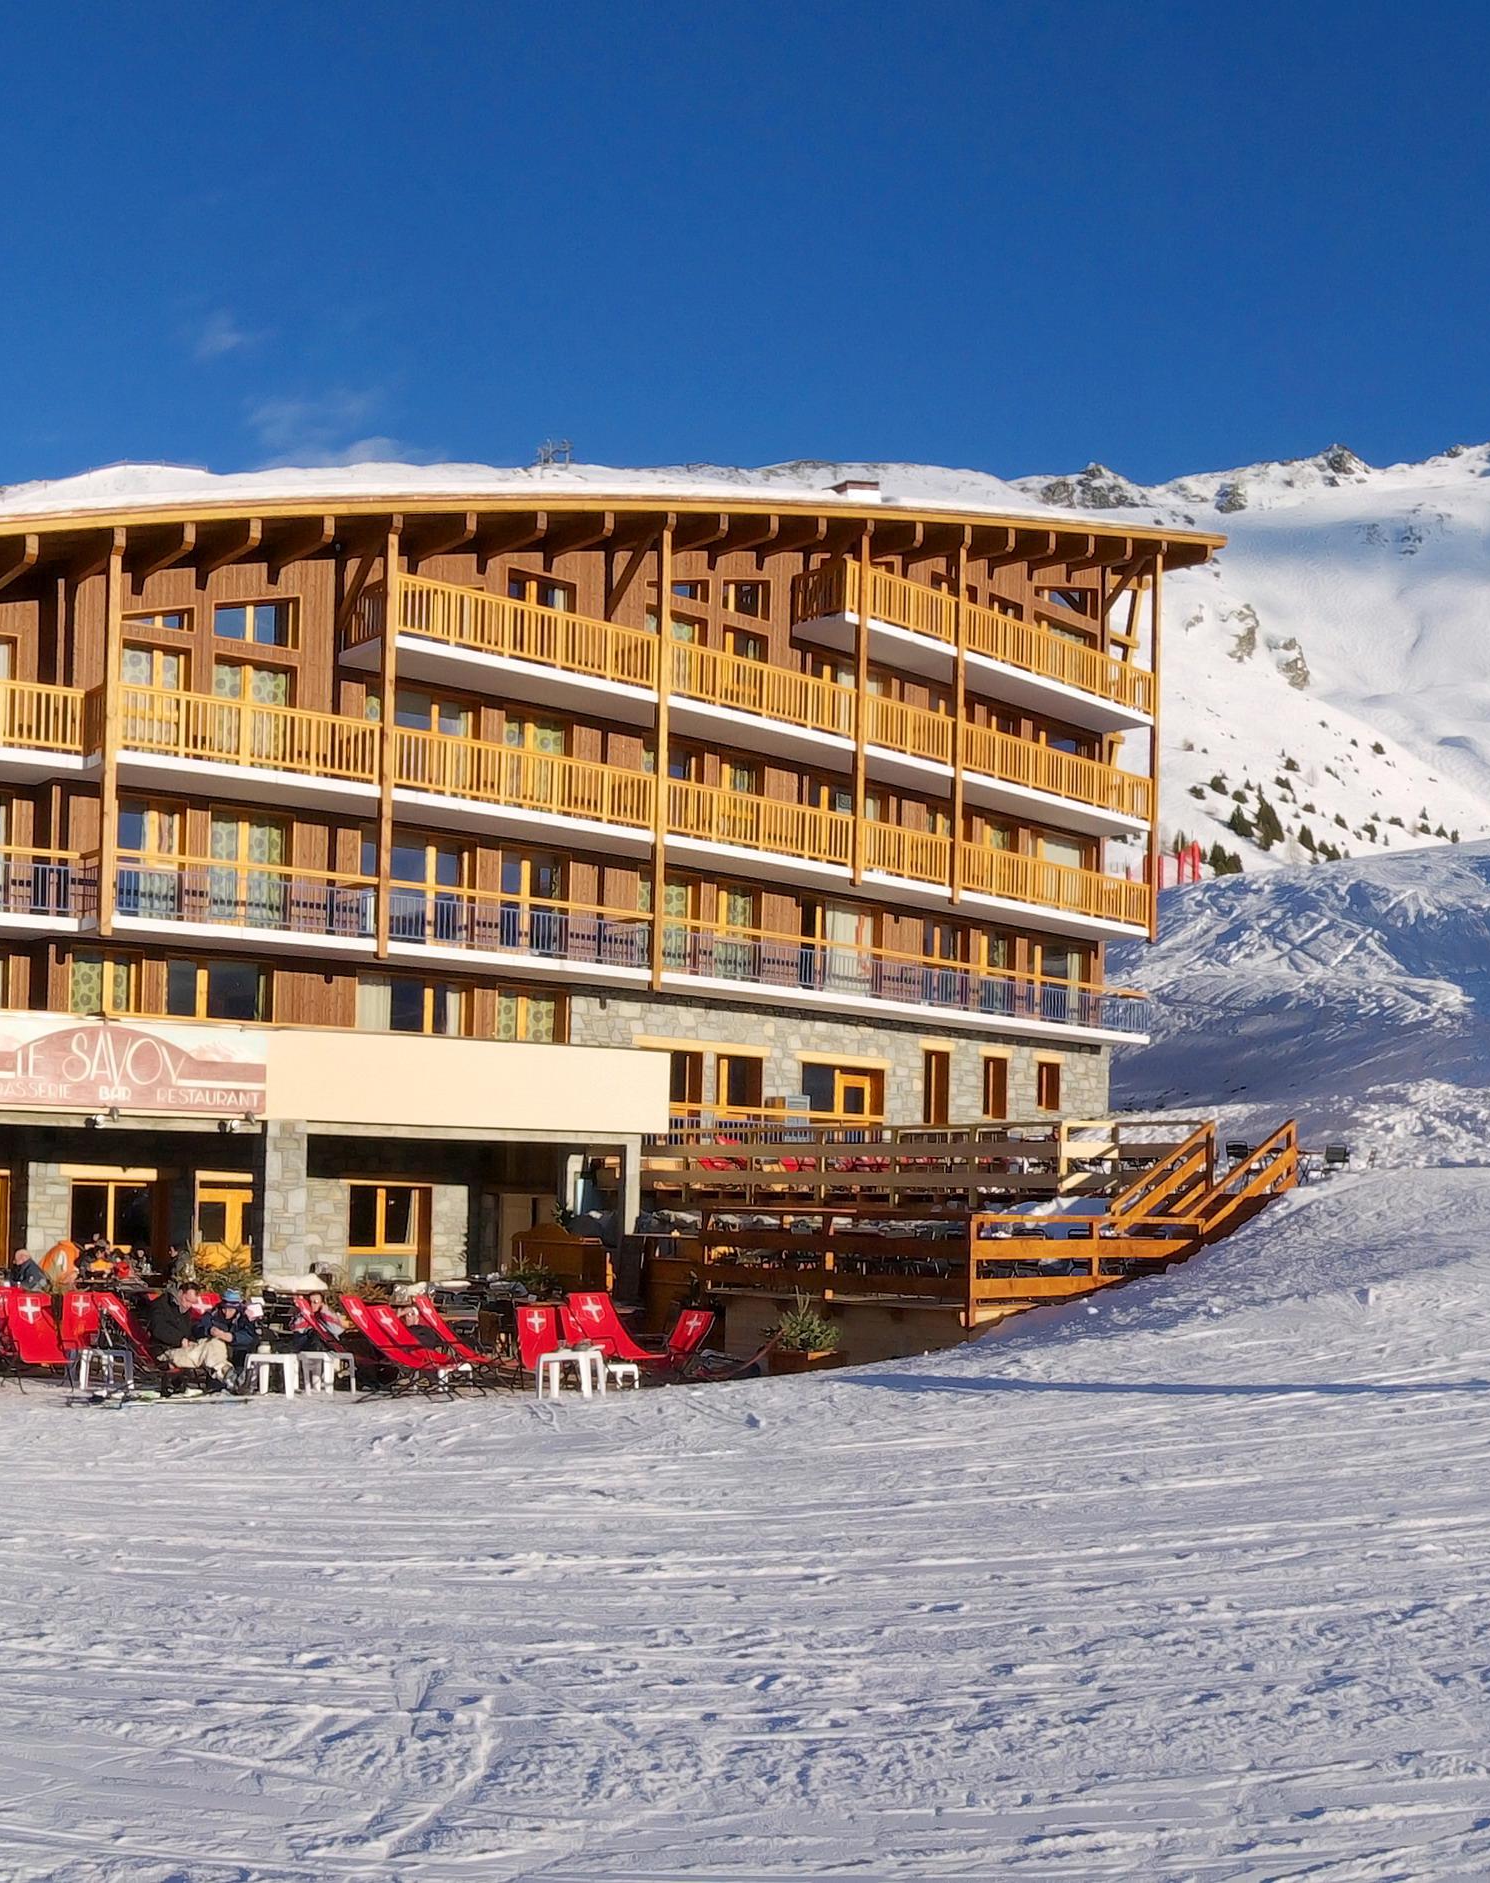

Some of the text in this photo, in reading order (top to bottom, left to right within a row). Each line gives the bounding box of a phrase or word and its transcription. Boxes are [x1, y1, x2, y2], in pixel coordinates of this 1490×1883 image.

[16, 1030, 188, 1086] LE SAVOY
[98, 1085, 132, 1101] BAR
[156, 1087, 260, 1108] RESTAURANT
